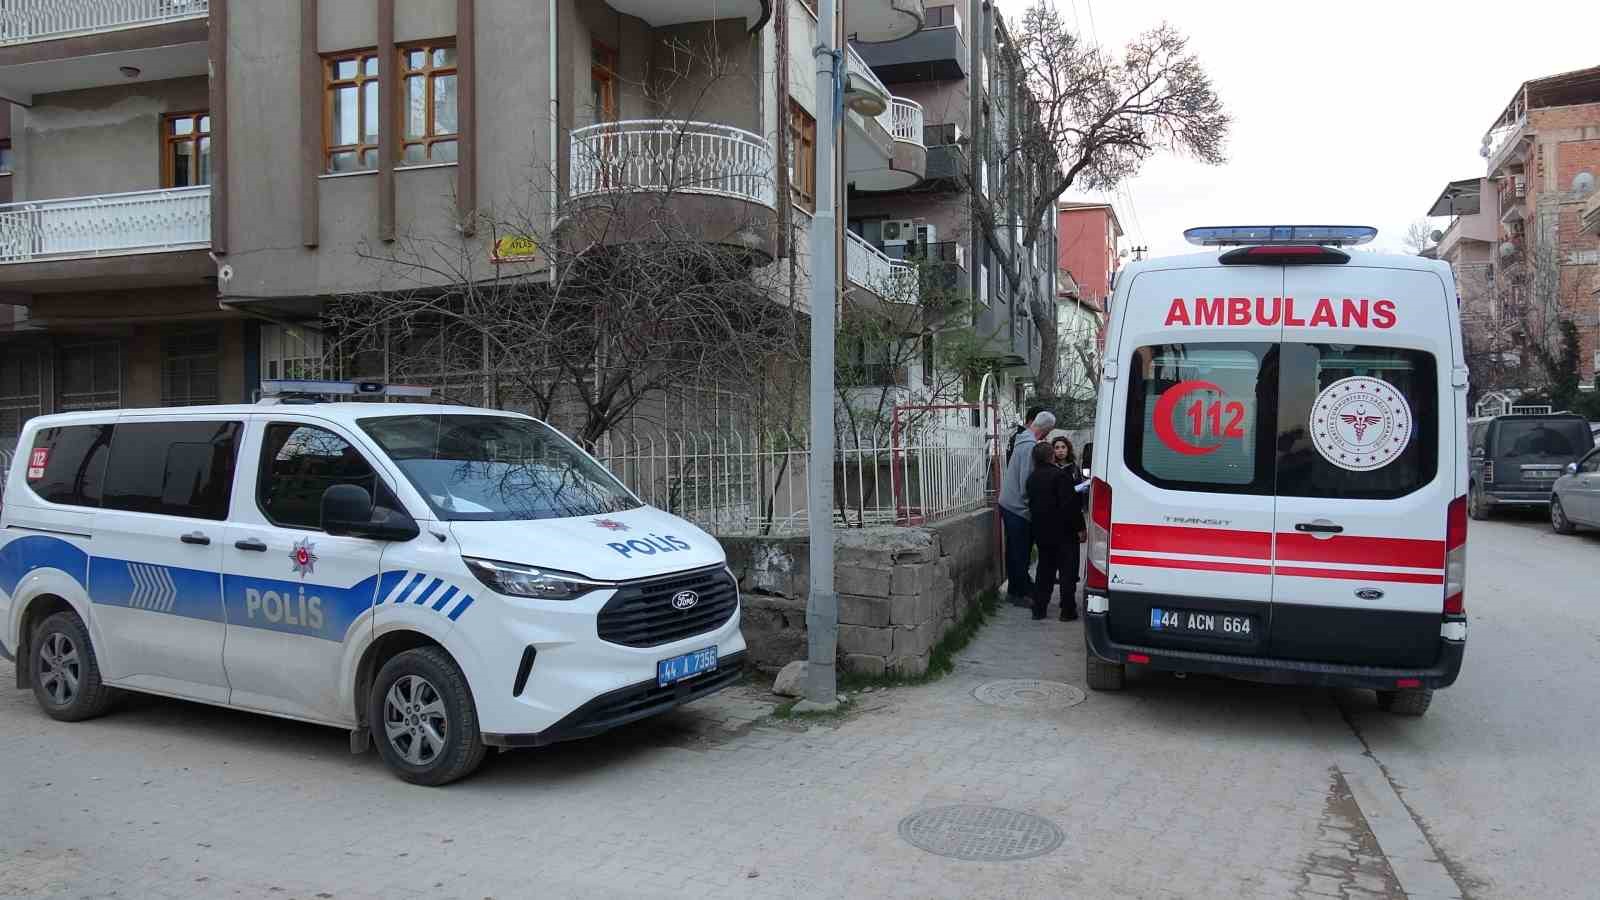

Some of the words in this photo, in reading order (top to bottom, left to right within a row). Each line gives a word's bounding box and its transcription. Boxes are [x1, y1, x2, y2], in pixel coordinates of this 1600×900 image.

[1165, 297, 1397, 329] AMBULANS
[1187, 400, 1245, 439] 112
[606, 533, 691, 559] POLİS
[246, 586, 323, 629] POLİS
[677, 592, 695, 607] Ford
[1161, 611, 1178, 628] 44
[1187, 613, 1215, 631] ACN
[1223, 616, 1250, 634] 664
[664, 661, 677, 681] 44
